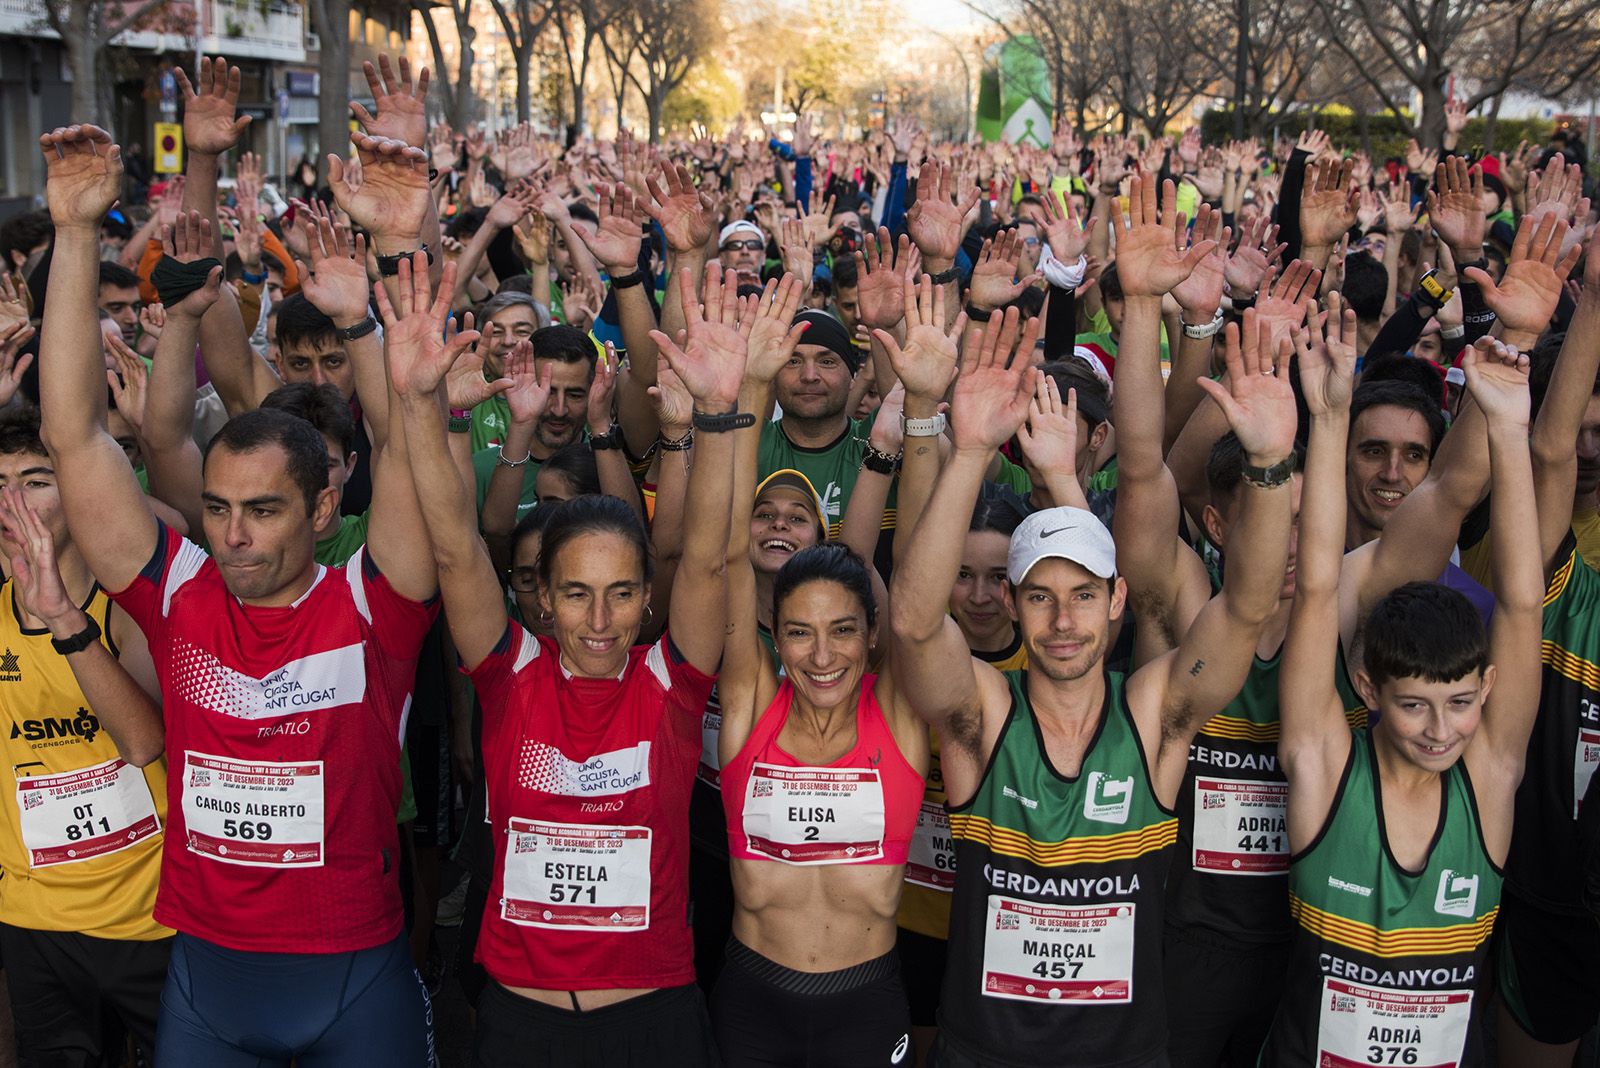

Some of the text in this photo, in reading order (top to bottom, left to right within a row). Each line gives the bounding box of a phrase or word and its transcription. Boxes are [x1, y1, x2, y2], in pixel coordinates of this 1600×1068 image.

[0, 673, 22, 681] uanvi
[265, 687, 336, 709] ANT CUGAT
[10, 713, 105, 741] ASMO
[257, 718, 311, 738] TRIATLÓ
[578, 758, 604, 772] UNIÓ
[1187, 744, 1277, 772] CERDAN
[49, 788, 55, 796] 31
[64, 780, 95, 793] DESEMBRE
[104, 772, 119, 783] 2023
[218, 772, 224, 780] 31
[225, 774, 233, 782] DE
[234, 775, 266, 785] DESEMBRE
[267, 777, 275, 785] DE
[277, 778, 295, 786] 2023
[579, 768, 620, 782] CICLISTA
[580, 771, 641, 792] SANT CUGAT
[791, 782, 798, 790] DE
[196, 795, 306, 818] CARLOS ALBERTO
[1243, 794, 1250, 802] DE
[1252, 794, 1281, 803] DESEMBRE
[73, 803, 93, 820] OT
[788, 807, 835, 822] ELISA
[65, 816, 111, 841] 811
[223, 819, 272, 841] 569
[1238, 815, 1286, 832] ADRIÀ
[804, 826, 820, 840] 2
[554, 838, 562, 846] DE
[564, 839, 596, 848] DESEMBRE
[598, 840, 605, 848] DE
[607, 840, 623, 848] 2023
[932, 836, 953, 852] MA
[1238, 835, 1281, 852] 441
[934, 853, 957, 871] 66
[544, 862, 608, 881] ESTELA
[983, 863, 1140, 898] CERDANYOLA
[549, 883, 597, 904] 571
[1030, 917, 1107, 928] 31 DE DESEMBRE DE 2023
[1023, 940, 1096, 962] MARÇAL
[1032, 961, 1084, 979] 457
[1318, 952, 1475, 987] CERDANYOLA
[1367, 1000, 1445, 1013] 31 DE DESEMBRE DE 2023
[1367, 1025, 1421, 1044] ADRIÀ
[1367, 1045, 1418, 1065] 376
